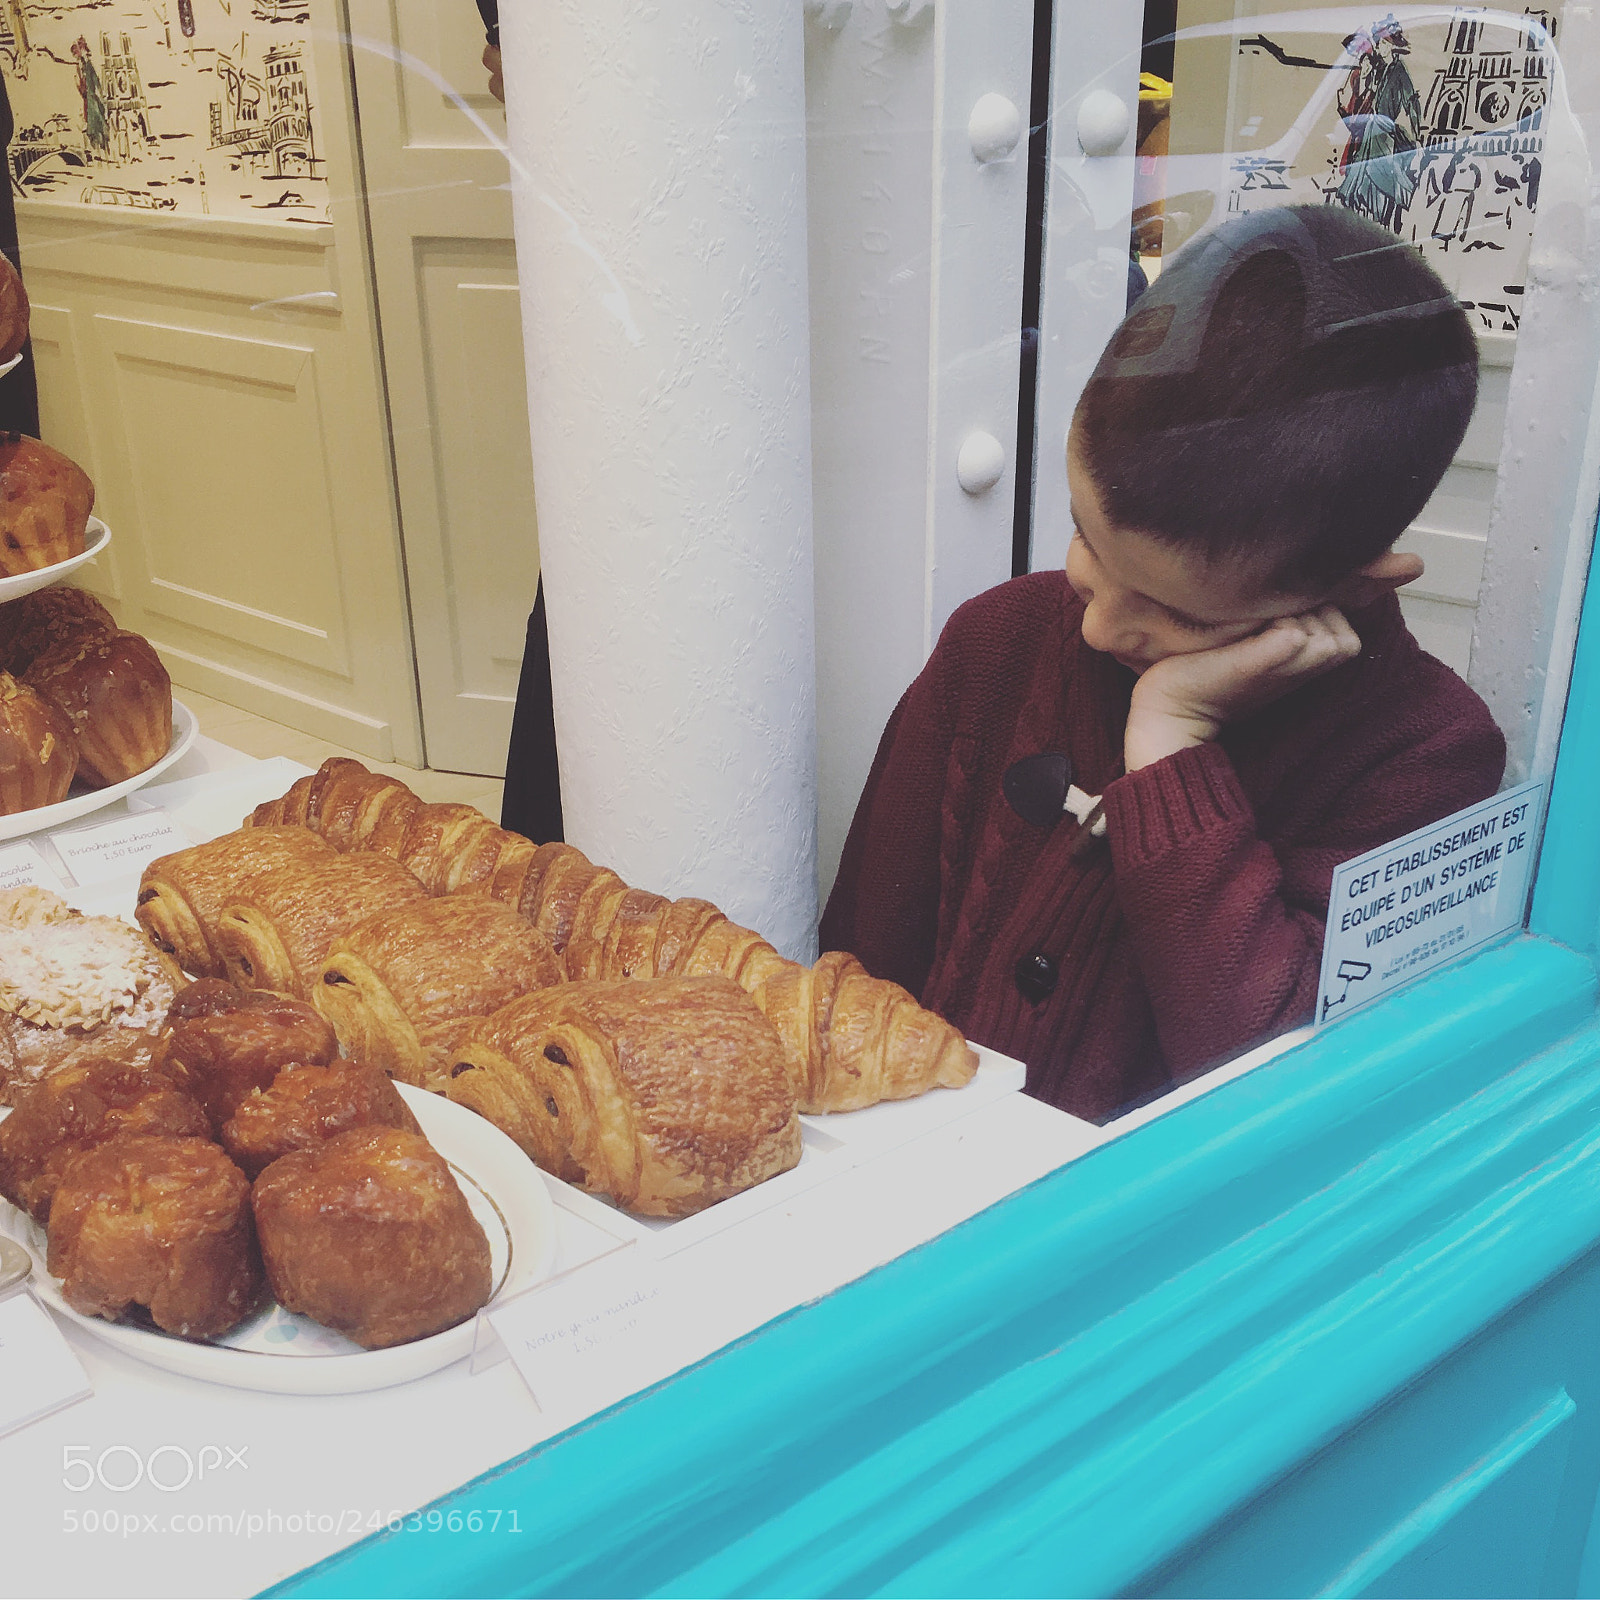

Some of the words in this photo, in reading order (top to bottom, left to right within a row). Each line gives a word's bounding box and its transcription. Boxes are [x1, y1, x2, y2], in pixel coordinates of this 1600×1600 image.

[68, 843, 110, 857] Brioche
[112, 838, 128, 847] au
[129, 827, 173, 841] chocolat
[103, 848, 126, 861] 1,50
[127, 844, 152, 855] Euro
[1349, 869, 1381, 898] CET
[1384, 816, 1498, 883] ÉTABLISSEMENT
[1502, 803, 1529, 829] EST
[0, 863, 33, 878] ocolat
[1341, 888, 1396, 932] ÉQUIPÉ
[1400, 874, 1435, 904] D'UN
[1507, 831, 1527, 854] DE
[1365, 871, 1499, 948] VIDEOSURVEILLANCE
